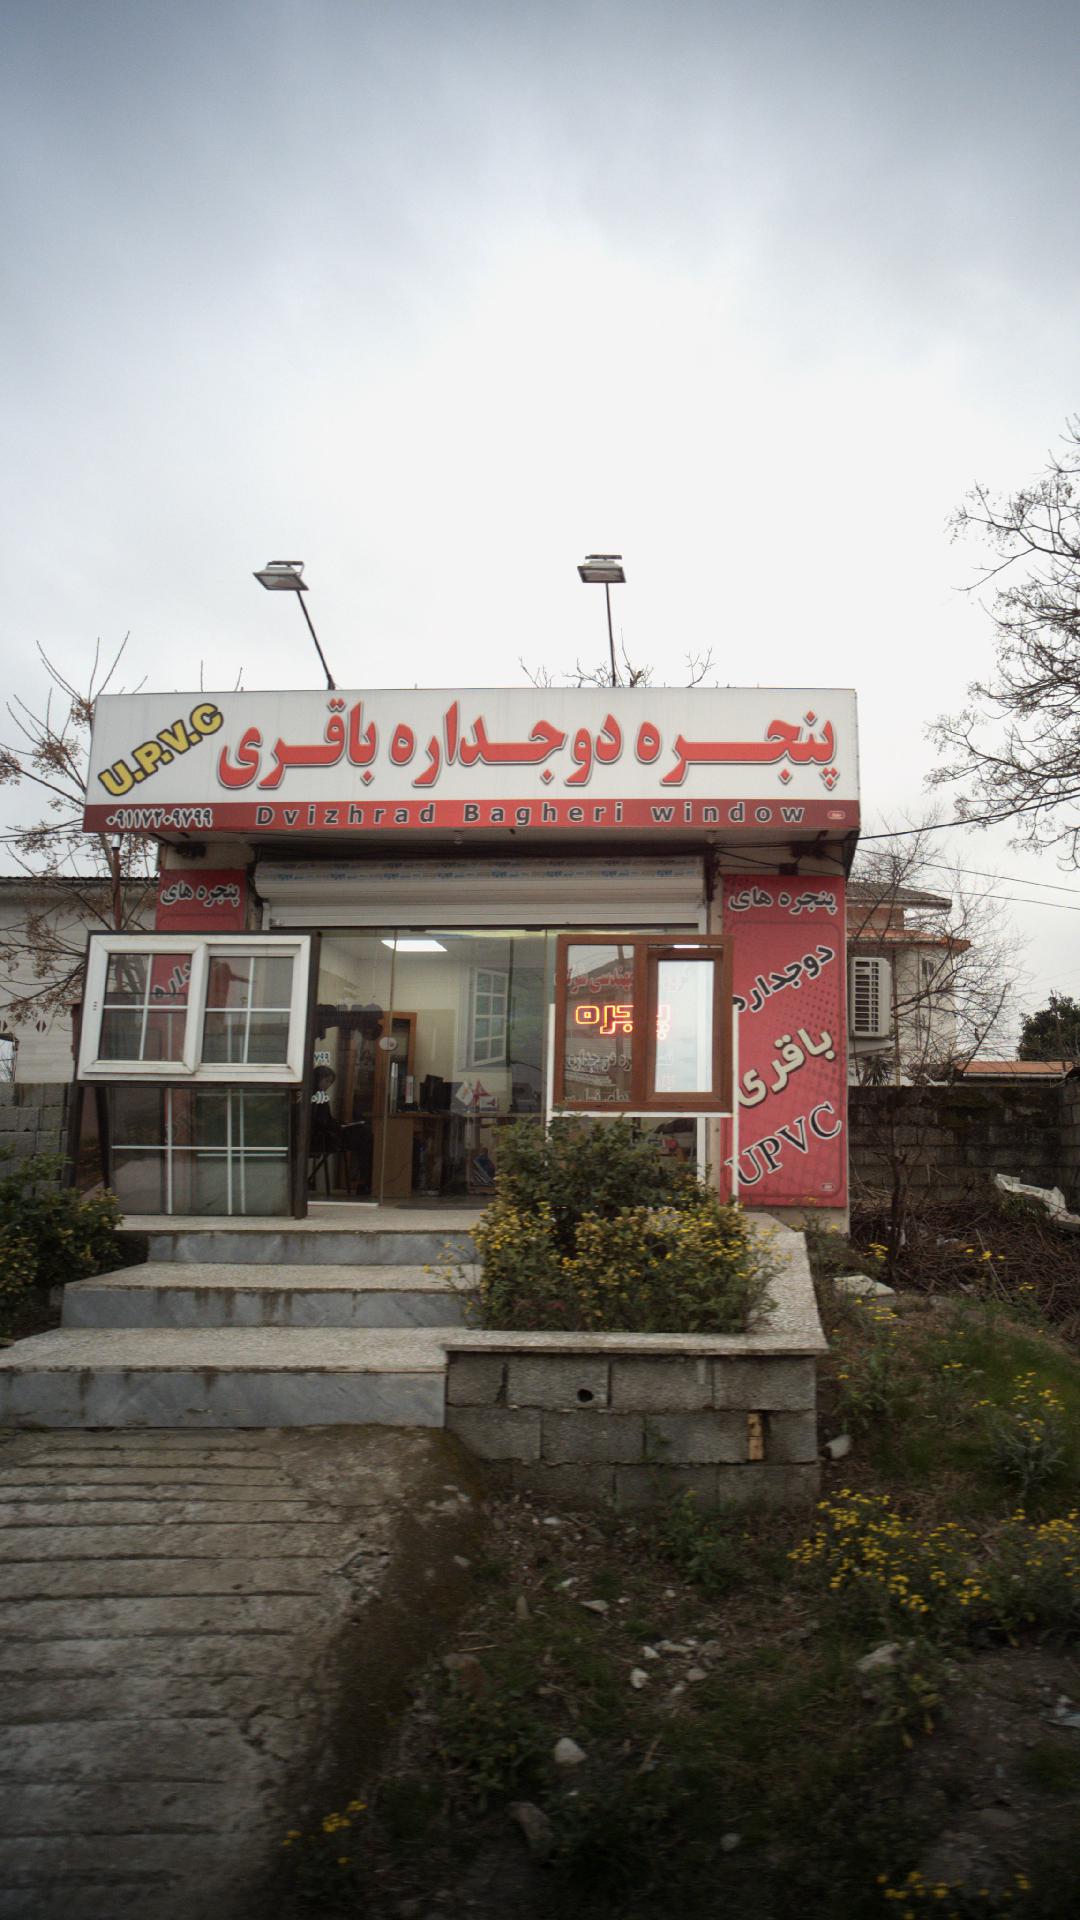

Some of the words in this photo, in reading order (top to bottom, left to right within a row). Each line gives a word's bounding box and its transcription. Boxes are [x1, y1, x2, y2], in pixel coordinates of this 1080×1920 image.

[98, 702, 224, 797] U.P.V.C
[217, 697, 380, 789] باقری
[635, 709, 838, 791] پنجره
[255, 803, 436, 826] Dvizhrad
[462, 801, 624, 827] Bagheri
[652, 801, 806, 823] window
[160, 880, 194, 906] های
[196, 883, 240, 908] پنجره
[728, 886, 773, 911] های
[778, 886, 837, 914] پنجره
[738, 1027, 836, 1108] باقری
[725, 1101, 842, 1186] UPVC
